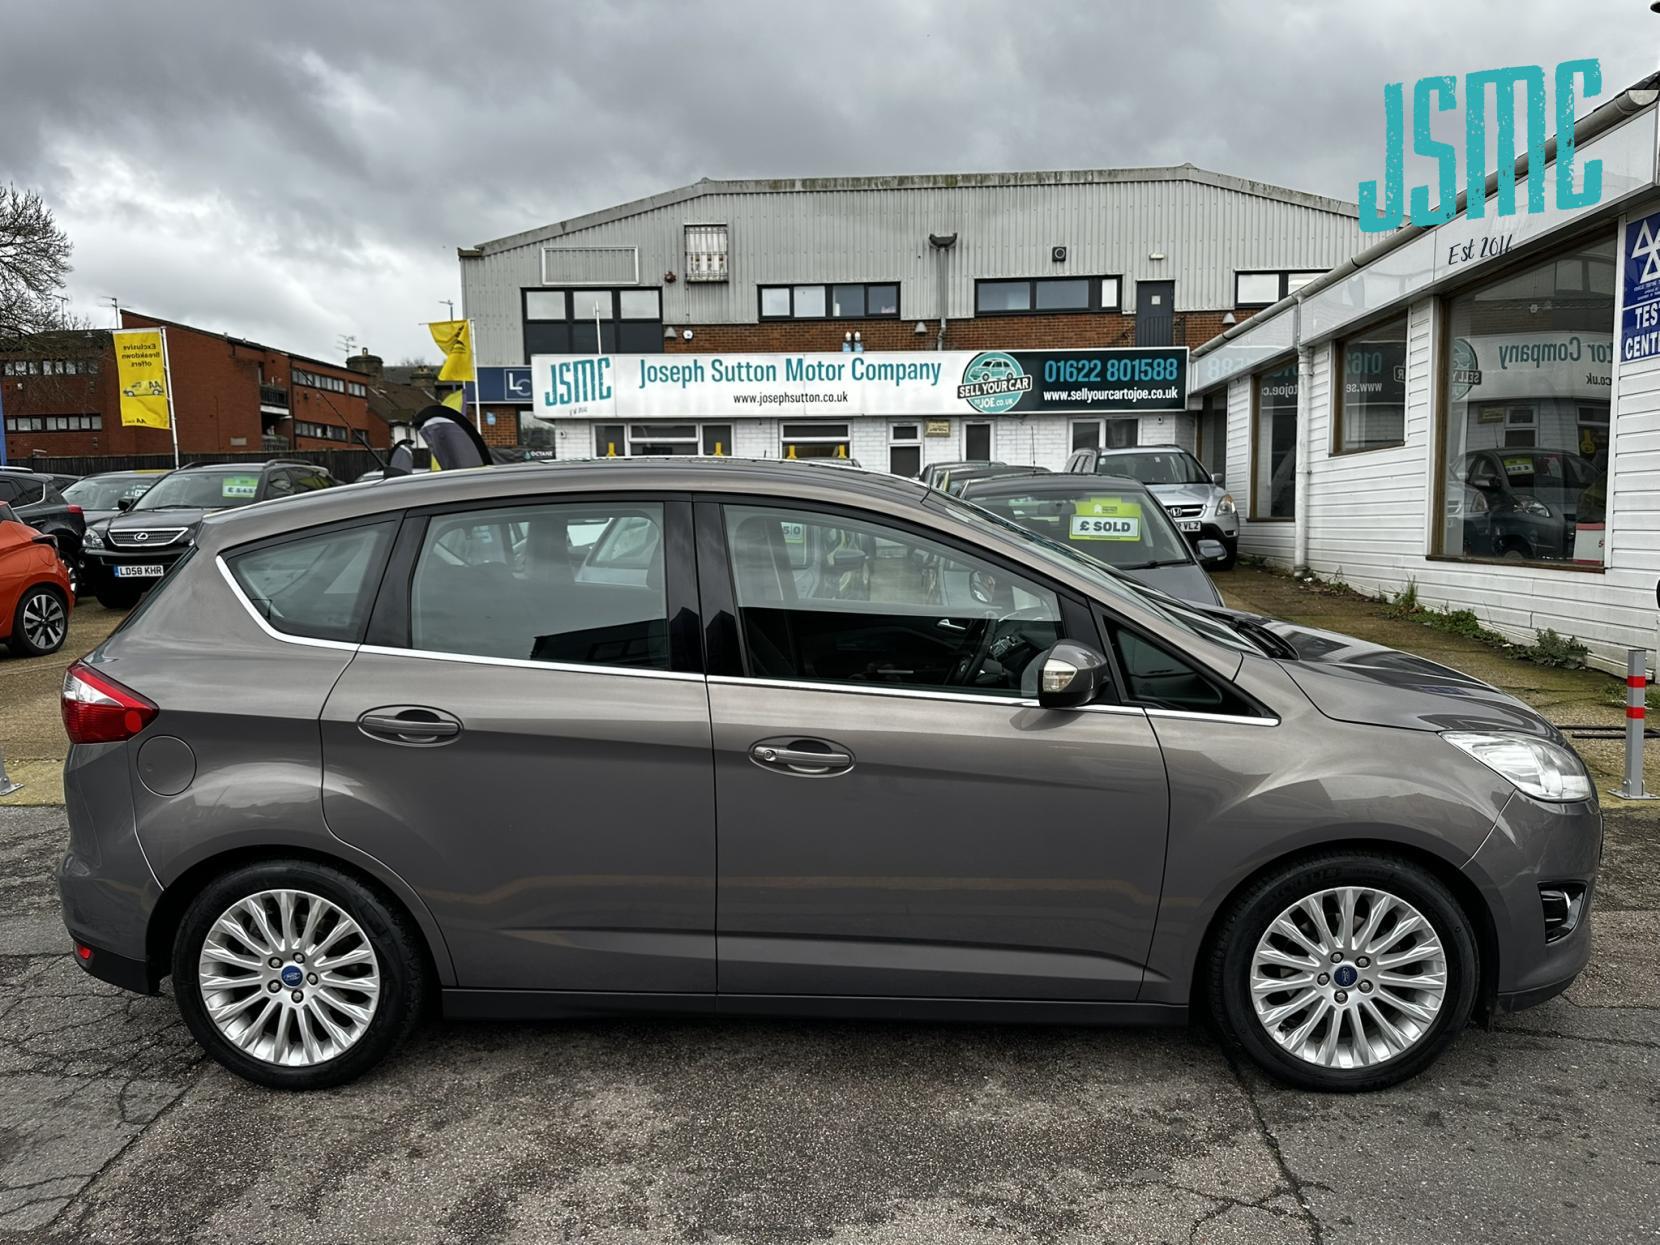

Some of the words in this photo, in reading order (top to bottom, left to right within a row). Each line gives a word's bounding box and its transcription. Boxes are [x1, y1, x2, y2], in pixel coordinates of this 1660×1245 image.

[1625, 332, 1660, 360] CENT
[639, 359, 704, 388] Joseph
[711, 359, 777, 382] Sutton
[785, 357, 845, 382] Motor
[851, 357, 941, 386] Company
[1044, 360, 1101, 382] 01622
[1106, 358, 1178, 381] 801588
[544, 356, 612, 407] JSMC
[959, 383, 981, 398] SELL
[982, 381, 1008, 395] YOUR
[1008, 378, 1029, 391] CAR
[733, 391, 848, 406] www.josephsutton.co.uk
[1043, 386, 1178, 403] www.sellyourcartojoe.co.uk
[1080, 521, 1089, 531] £
[1093, 521, 1131, 532] SOLD
[118, 566, 143, 576] LD58
[144, 565, 162, 575] KHR
